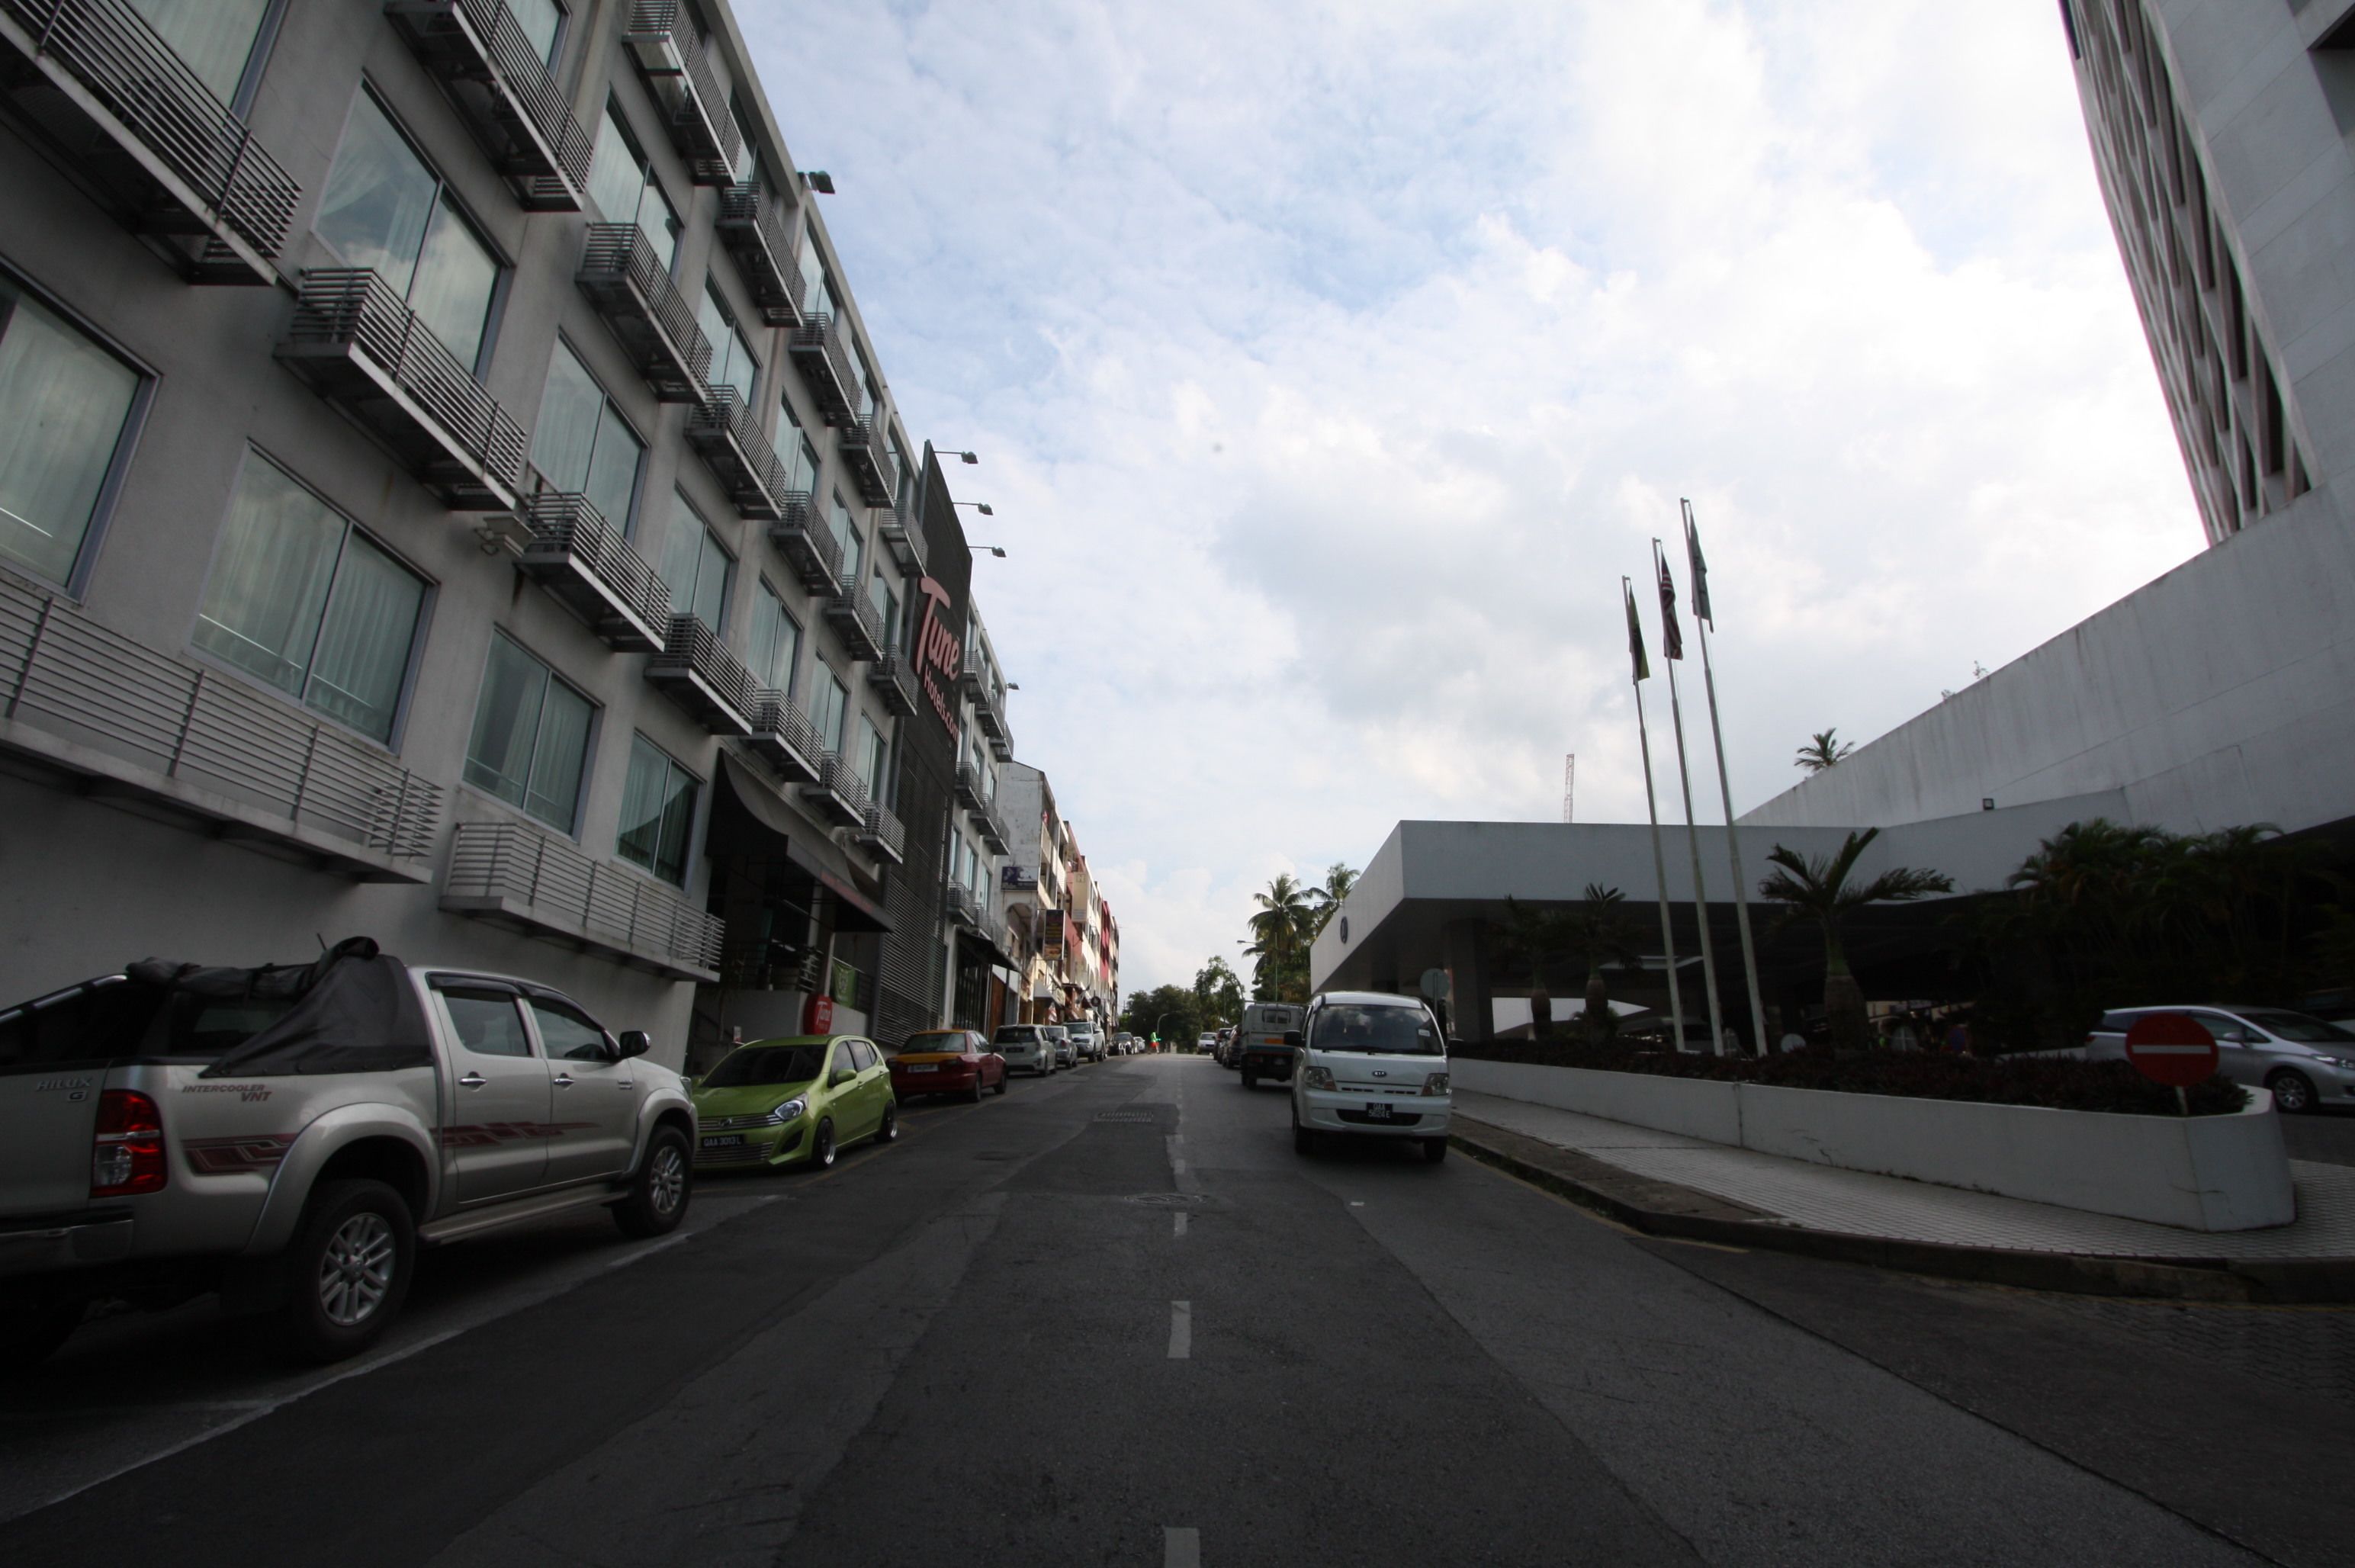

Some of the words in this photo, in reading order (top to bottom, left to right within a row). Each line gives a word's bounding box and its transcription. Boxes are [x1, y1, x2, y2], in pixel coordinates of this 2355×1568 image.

[917, 576, 959, 681] Tune
[923, 664, 959, 744] Hotels.com
[36, 1078, 90, 1091] HILUX
[182, 1084, 265, 1094] INTERCOOLER
[69, 1091, 83, 1100] G
[239, 1091, 272, 1102] VNT
